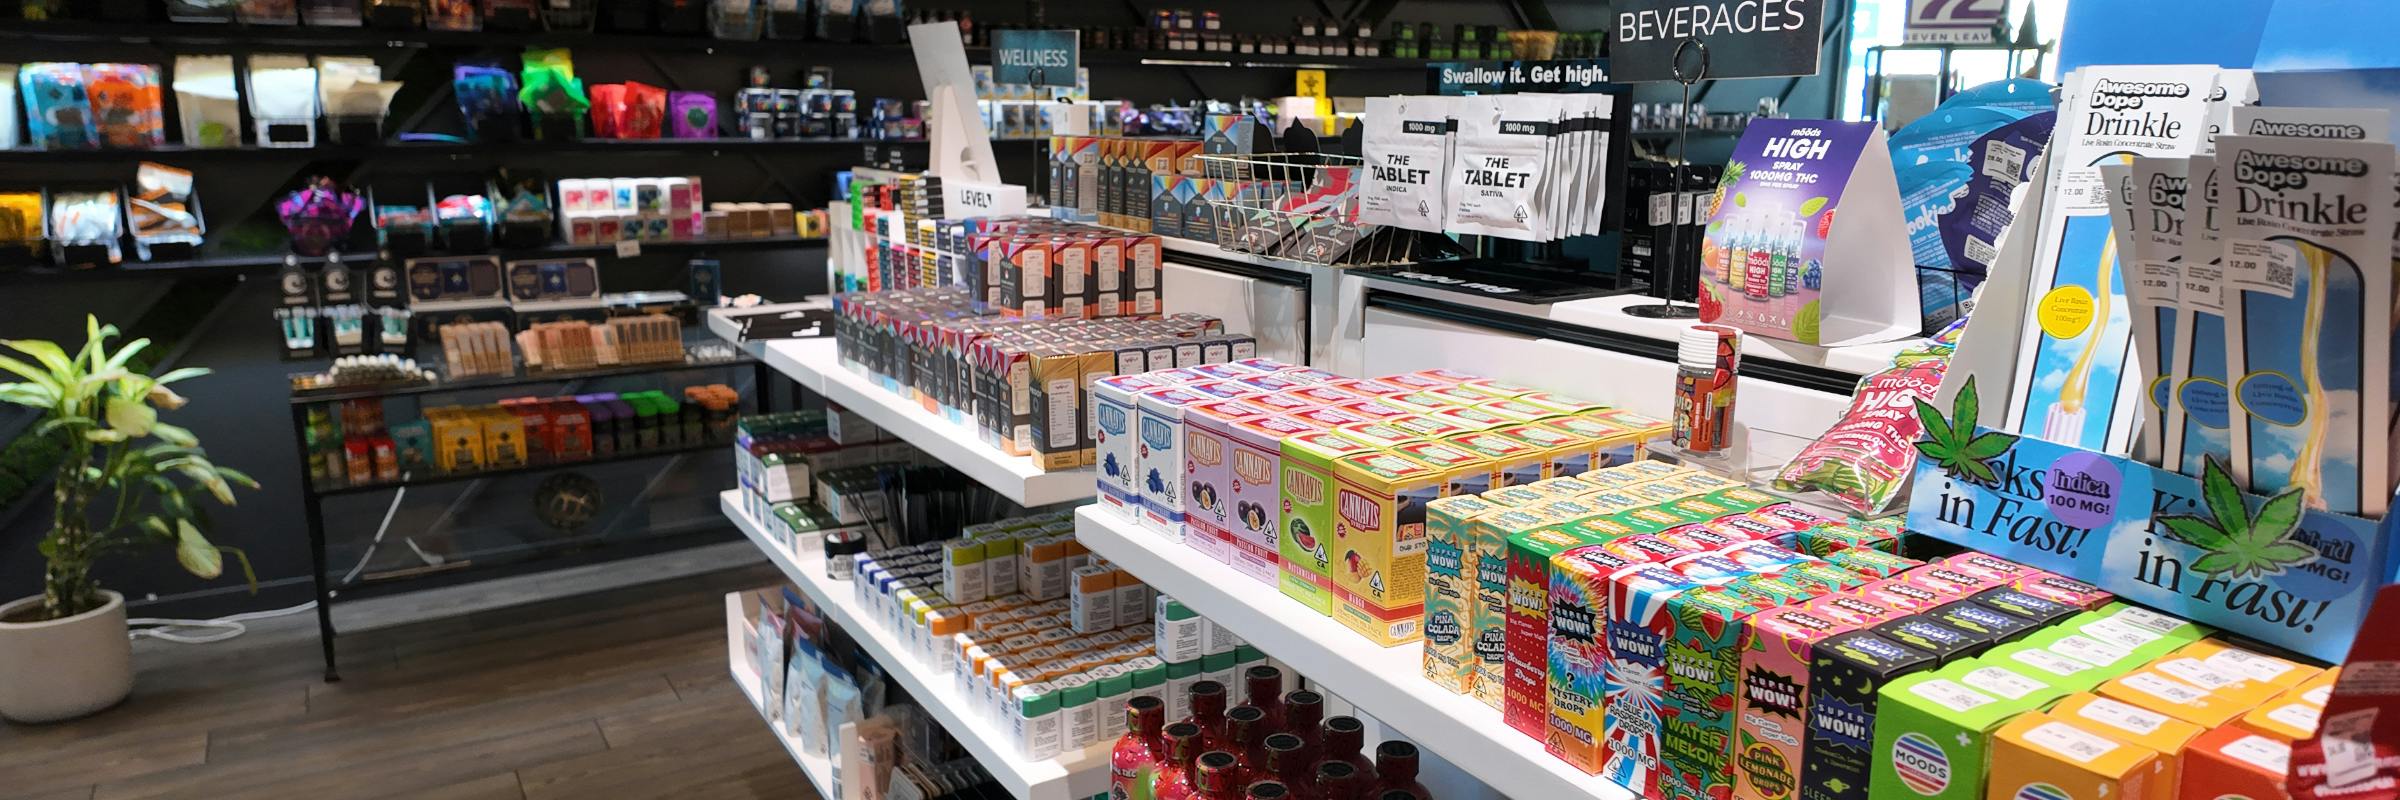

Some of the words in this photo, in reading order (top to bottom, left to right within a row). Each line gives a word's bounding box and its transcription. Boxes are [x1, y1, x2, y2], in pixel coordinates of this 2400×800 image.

[1620, 0, 1805, 42] BEVERAGES
[998, 48, 1069, 67] WELLNESS
[1443, 67, 1506, 84] Swallow
[1509, 66, 1526, 83] it.
[1531, 66, 1560, 83] Get
[1565, 64, 1609, 84] high.
[2094, 78, 2189, 97] Awesome
[2091, 93, 2143, 111] Dope
[1408, 122, 1423, 132] 1000
[1424, 124, 1436, 133] mg
[1505, 122, 1521, 132] 1000
[1522, 124, 1536, 134] mg
[1791, 127, 1822, 137] mööds
[2084, 111, 2181, 139] Drinkle
[2251, 119, 2362, 138] Awesome
[1762, 137, 1832, 160] HIGH
[1387, 154, 1410, 166] THE
[1484, 157, 1509, 169] THE
[1772, 161, 1805, 171] SPRAY
[2237, 151, 2364, 174] Awesome
[1371, 165, 1430, 185] TABLET
[1465, 169, 1530, 188] TABLET
[1750, 170, 1793, 182] 1000MG
[1795, 173, 1819, 184] THC
[2236, 165, 2303, 188] Dope
[961, 189, 988, 208] LEVEL
[1481, 189, 1504, 198] SATIVA
[2236, 186, 2367, 225] Drinkle
[2230, 260, 2256, 269] 12.00
[2143, 280, 2168, 288] 12.00
[2185, 283, 2210, 293] 12.00
[1885, 424, 1909, 449] THC
[1189, 433, 1222, 463] CANNAVIS
[1235, 450, 1271, 482] CANNAVIS
[1286, 468, 1323, 502] CANNAVIS
[2053, 469, 2110, 498] Indica
[1340, 491, 1379, 528] CANNAVIS
[2050, 494, 2076, 508] 100
[2079, 501, 2110, 515] MG!
[1936, 481, 1974, 529] in
[1982, 497, 2090, 559] Fast!
[1431, 554, 1458, 569] WOW!
[1481, 562, 1507, 573] SUPE
[2134, 537, 2181, 594] in
[1372, 589, 1382, 598] CA
[1513, 593, 1544, 611] WOW!
[1435, 612, 1454, 624] PIÑA
[1556, 606, 1590, 623] SUPER
[1428, 624, 1460, 635] COLADA
[1555, 616, 1591, 636] WOW!
[1616, 627, 1653, 644] SUPER
[1616, 636, 1655, 658] WOW!
[1507, 650, 1545, 680] Strawberry
[1673, 652, 1713, 670] SUPER
[1514, 668, 1536, 686] Drops
[1673, 661, 1716, 684] WOW!
[1750, 675, 1795, 693] SUPER
[1507, 687, 1528, 705] 1000
[1529, 697, 1544, 713] MG
[1550, 684, 1593, 709] MYSTERY
[1553, 696, 1585, 716] DROPS
[1749, 685, 1796, 709] WOW!
[1609, 705, 1655, 733] RASPBERRY
[1623, 702, 1642, 719] BLUE
[1818, 703, 1864, 724] SUPER
[1550, 714, 1573, 735] 1000
[1575, 727, 1592, 744] MG
[1619, 720, 1645, 739] DROPS
[1667, 714, 1721, 750] WATER
[1817, 713, 1866, 741] WOW!
[1609, 739, 1634, 759] 1000
[1637, 753, 1656, 769] MG
[1666, 734, 1721, 768] MELON
[1754, 750, 1780, 767] PINK
[1740, 756, 1793, 787] LEMONADE
[1895, 749, 1947, 779] MOODS
[1661, 773, 1682, 788] 1000
[1682, 785, 1697, 797] mg
